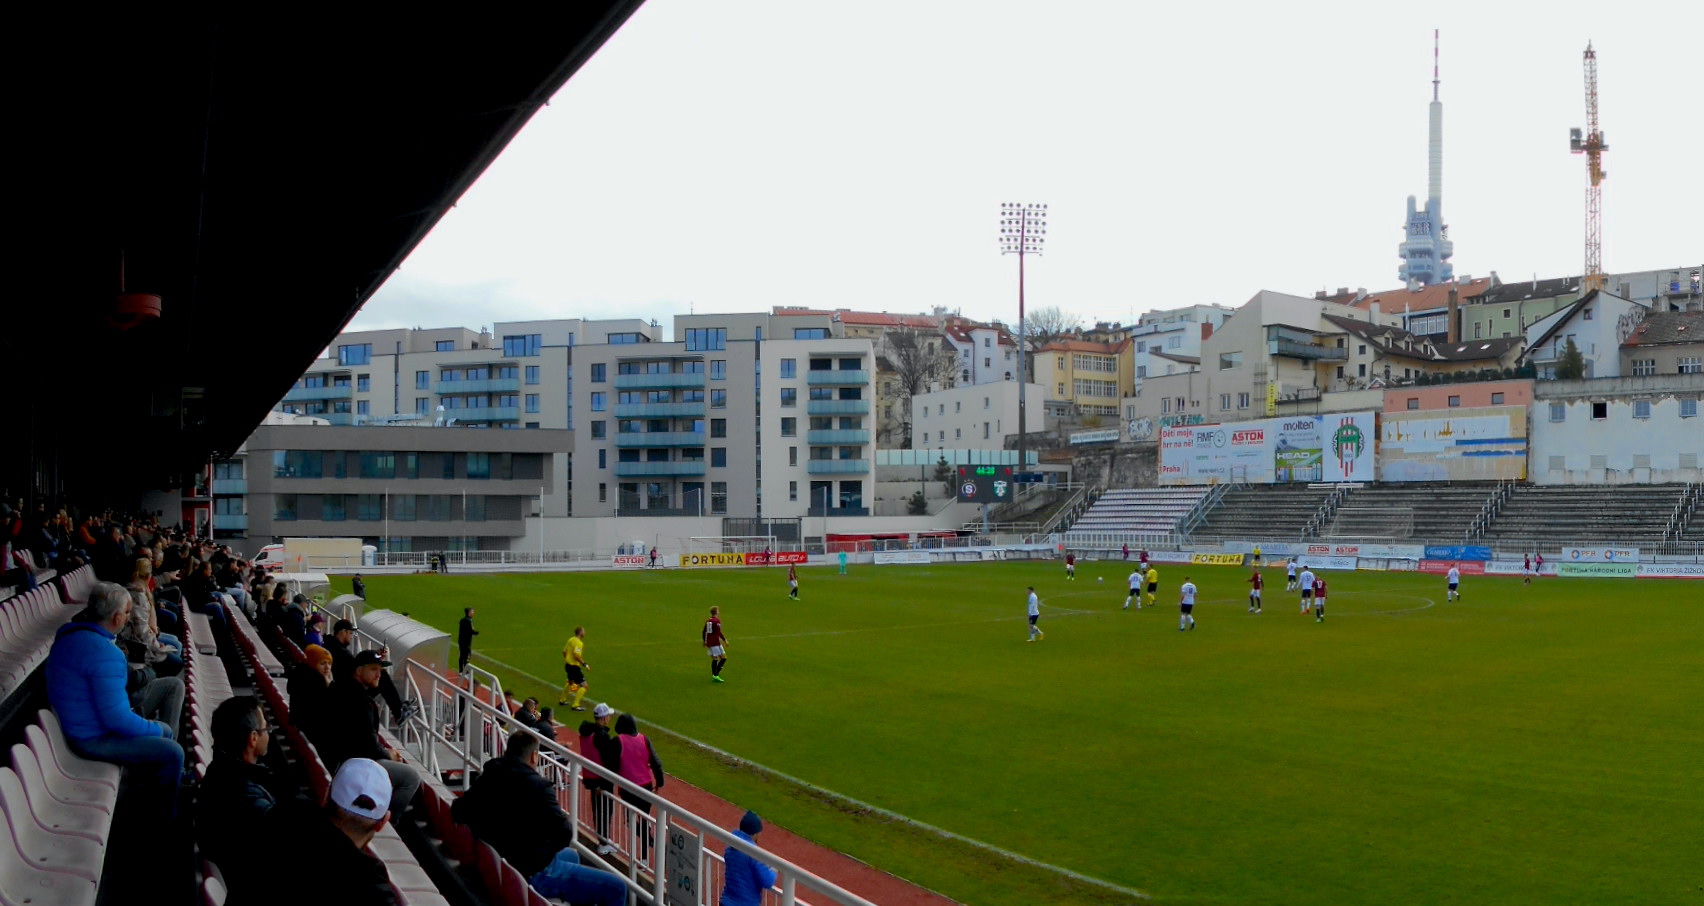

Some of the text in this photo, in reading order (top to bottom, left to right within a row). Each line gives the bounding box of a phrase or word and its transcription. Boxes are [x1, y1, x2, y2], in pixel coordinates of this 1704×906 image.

[1283, 420, 1314, 431] molten
[1162, 429, 1175, 438] Děti
[1196, 431, 1214, 442] RMF
[1231, 431, 1264, 442] ASTON
[1183, 439, 1194, 448] ně!
[1276, 452, 1311, 460] HEAD
[1162, 465, 1181, 473] Praha
[682, 554, 744, 566] FORTUNA
[1194, 554, 1242, 564] FORTUNA
